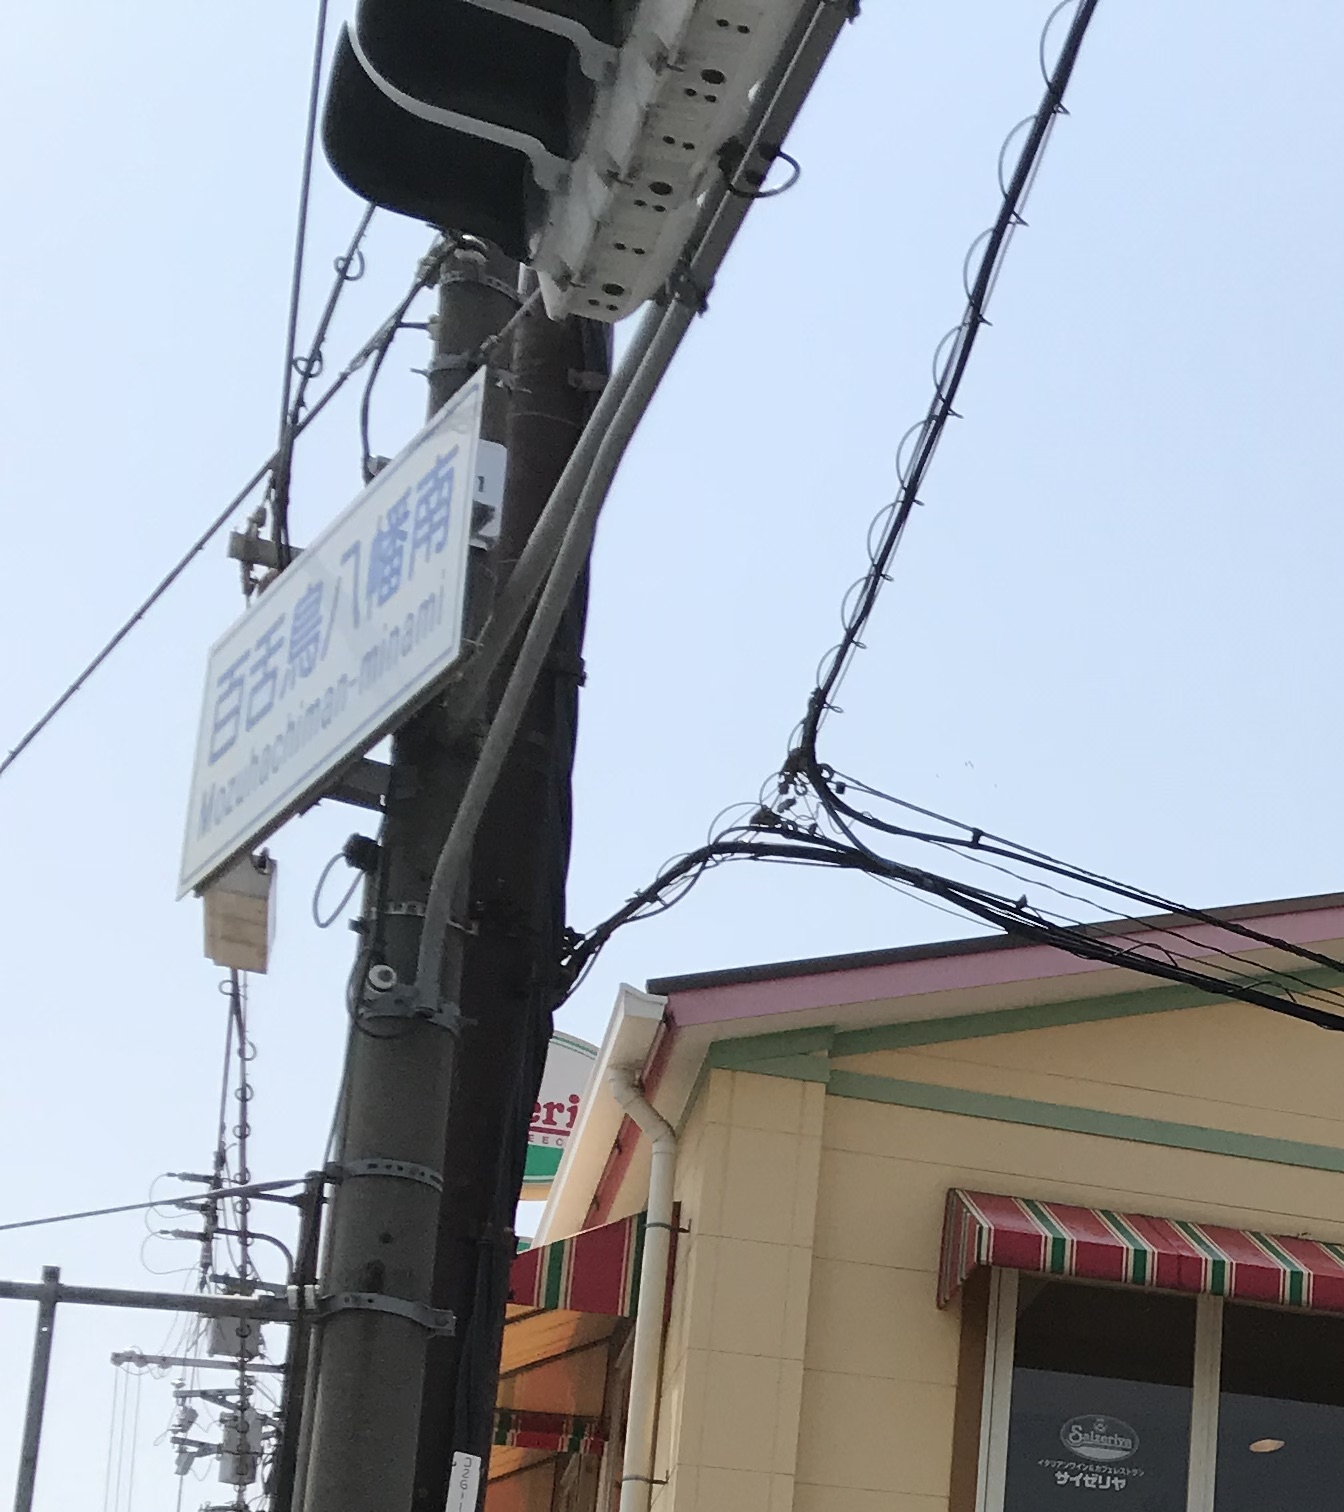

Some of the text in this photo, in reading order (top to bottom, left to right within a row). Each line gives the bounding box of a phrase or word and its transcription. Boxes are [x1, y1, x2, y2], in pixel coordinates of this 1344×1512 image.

[208, 444, 459, 767] 百舌鳥八幡南
[1054, 1471, 1126, 1491] サイゼリヤ
